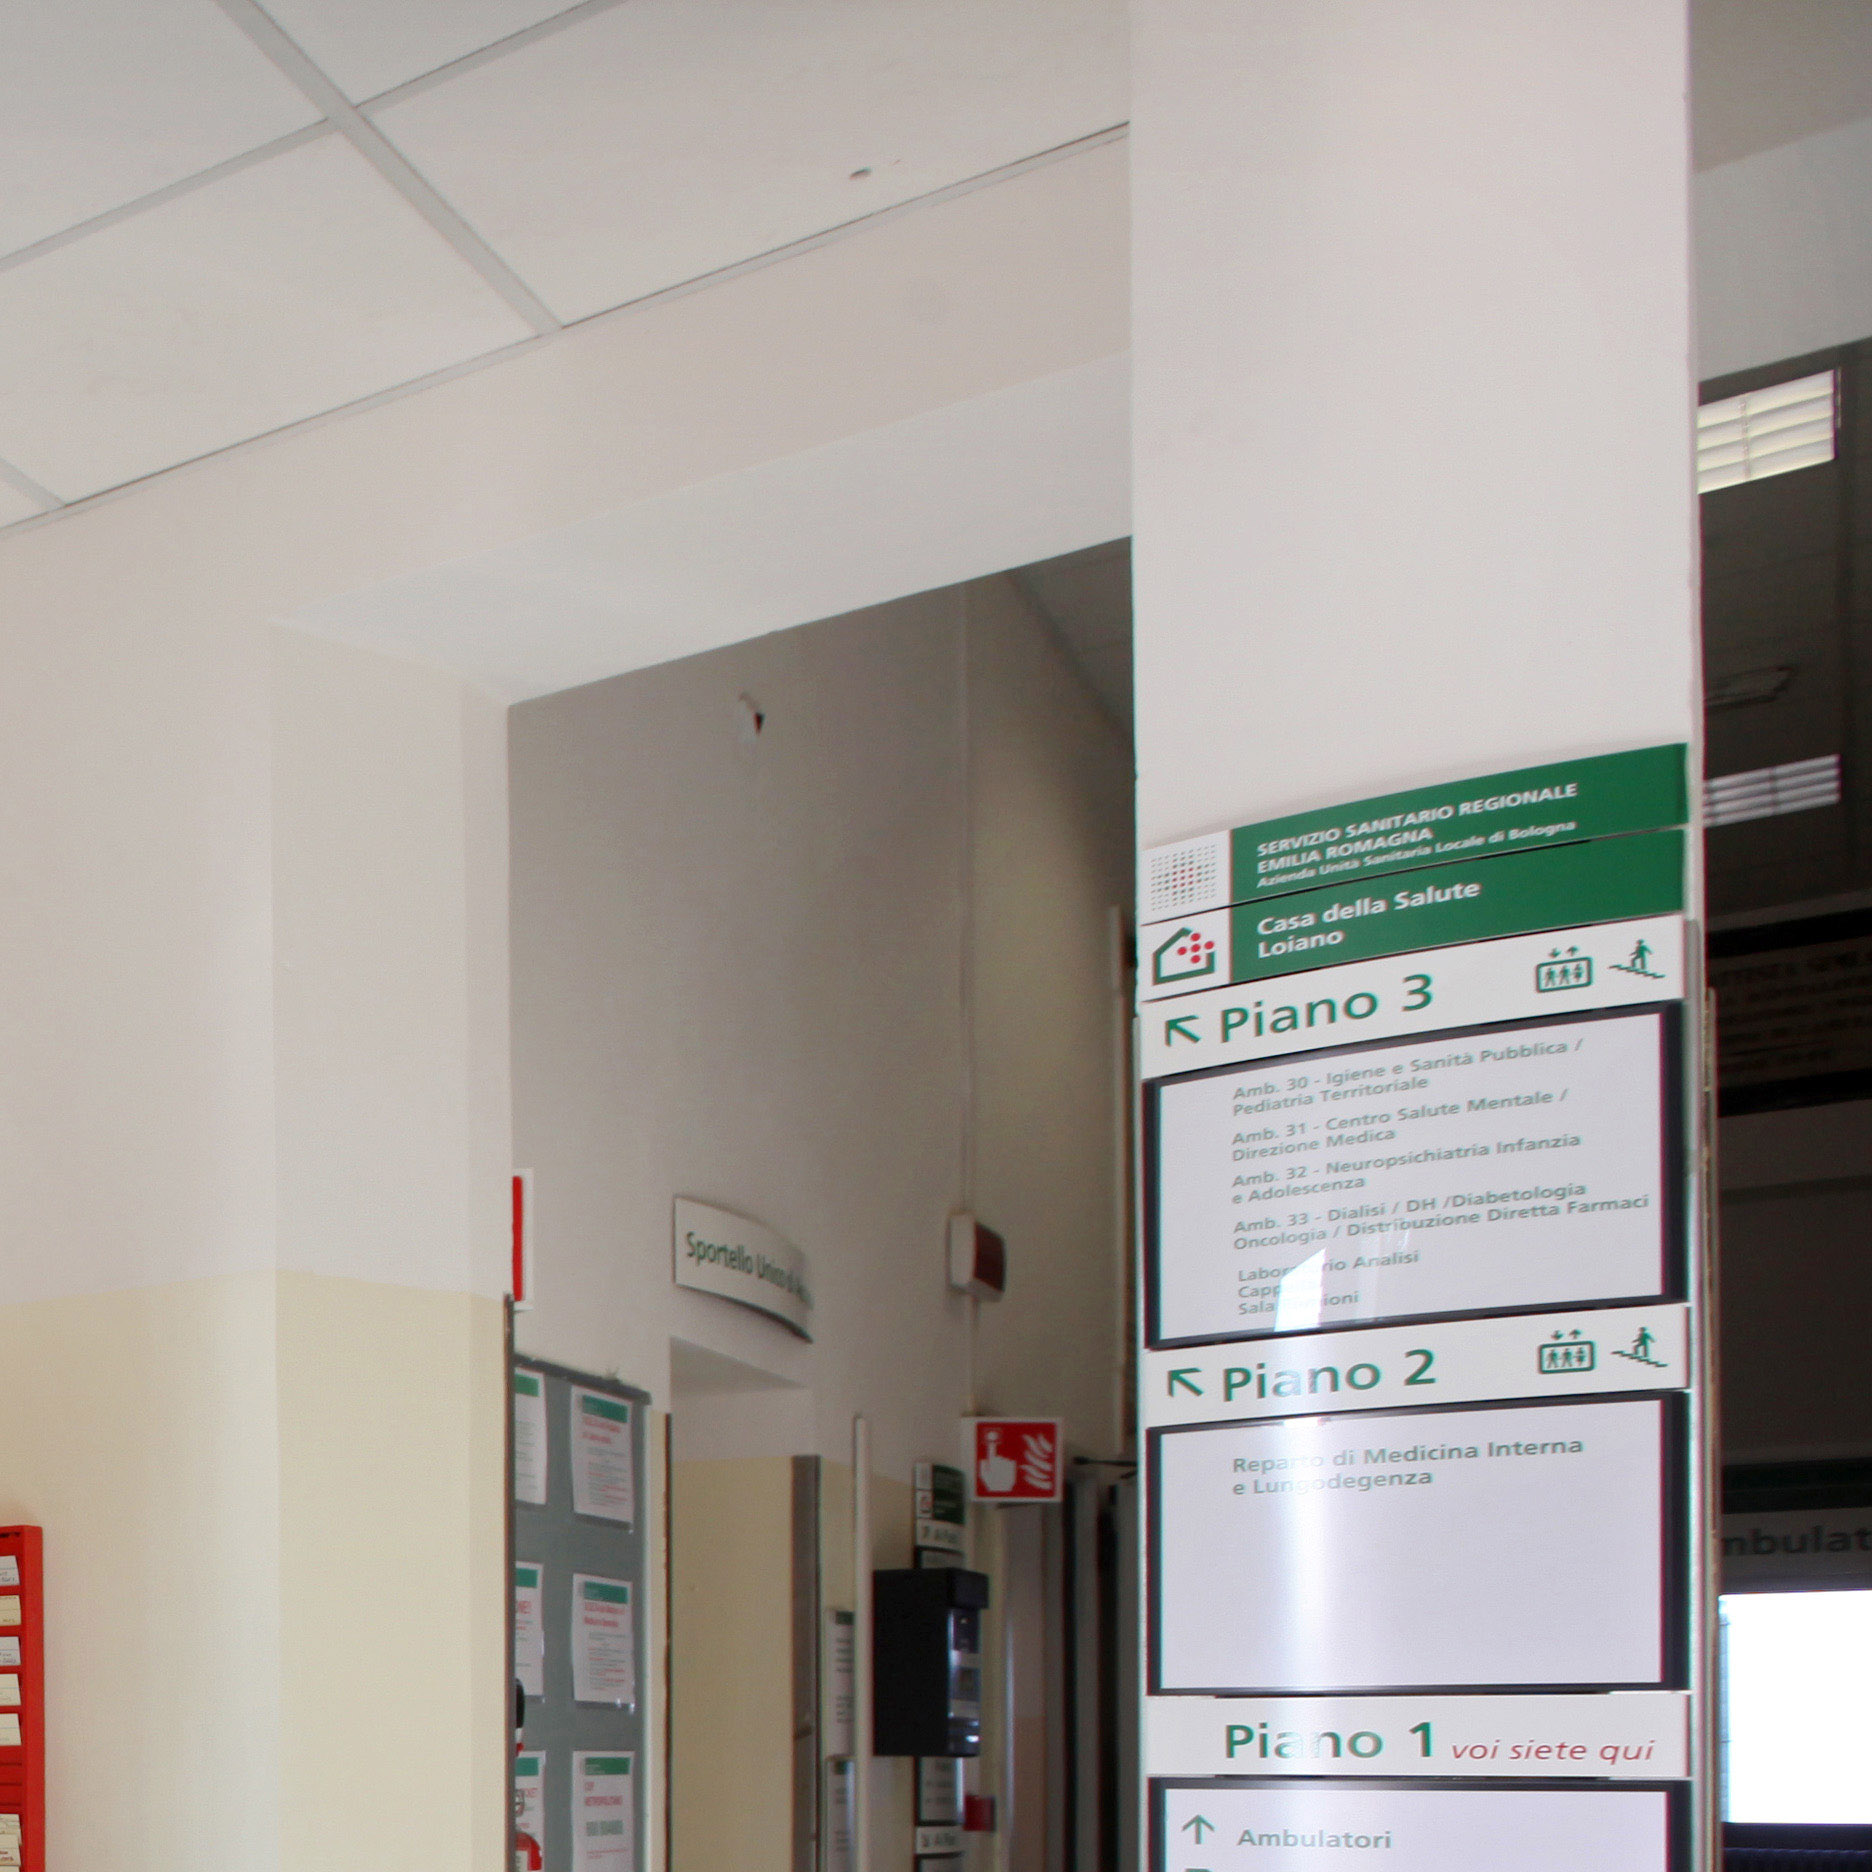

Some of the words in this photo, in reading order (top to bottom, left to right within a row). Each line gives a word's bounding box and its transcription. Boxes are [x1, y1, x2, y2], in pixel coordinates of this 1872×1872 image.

[1258, 828, 1342, 857] SERVIZIO
[1345, 807, 1455, 840] SANITARIO
[1459, 783, 1578, 819] REGIONALE
[1258, 850, 1320, 874] EMILIA
[1326, 828, 1433, 861] ROMAGNA
[1258, 910, 1316, 935] Casa
[1322, 898, 1387, 924] della
[1394, 882, 1481, 911] Salute
[1258, 931, 1344, 958] Loiano
[1219, 992, 1378, 1043] Piano
[1402, 974, 1434, 1010] 3
[1233, 1081, 1280, 1099] Amb.
[1285, 1077, 1308, 1092] 30
[1326, 1066, 1386, 1089] Igiene
[1392, 1064, 1402, 1078] e
[1410, 1054, 1472, 1076] Sanità
[1480, 1041, 1567, 1066] Pubblica
[1232, 1128, 1279, 1145] Amb.
[1285, 1124, 1307, 1139] 31
[1326, 1113, 1390, 1133] Centro
[1397, 1103, 1459, 1124] Salute
[1466, 1091, 1552, 1115] Mentale
[1233, 1091, 1313, 1116] Pediatria
[1321, 1075, 1428, 1104] Territoriale
[1232, 1136, 1319, 1162] Direzione
[1326, 1127, 1395, 1149] Medica
[1232, 1170, 1278, 1188] Amb.
[1284, 1167, 1307, 1182] 32
[1326, 1145, 1489, 1179] Neuropsichiatria
[1497, 1134, 1580, 1156] Infanzia
[1232, 1189, 1242, 1204] e
[1249, 1175, 1365, 1202] Adolescenza
[1234, 1216, 1279, 1234] Amb.
[1288, 1213, 1307, 1228] 33
[1328, 1204, 1385, 1223] Dialisi
[1406, 1198, 1435, 1215] DH
[1234, 1227, 1326, 1253] Oncologia
[1488, 1203, 1560, 1224] Diretta
[1568, 1193, 1648, 1216] Farmaci
[686, 1231, 753, 1274] Sportello
[1222, 1359, 1381, 1402] Piano
[1404, 1349, 1436, 1385] 2
[1333, 1451, 1355, 1468] di
[1364, 1444, 1478, 1466] Medicina
[1488, 1437, 1583, 1459] Interna
[1232, 1482, 1244, 1496] e
[1224, 1722, 1384, 1759] Piano
[1408, 1721, 1435, 1758] 1
[1452, 1739, 1498, 1761] voi
[1508, 1739, 1586, 1762] siete
[1601, 1738, 1655, 1767] qui
[1237, 1826, 1392, 1850] Ambulatori
